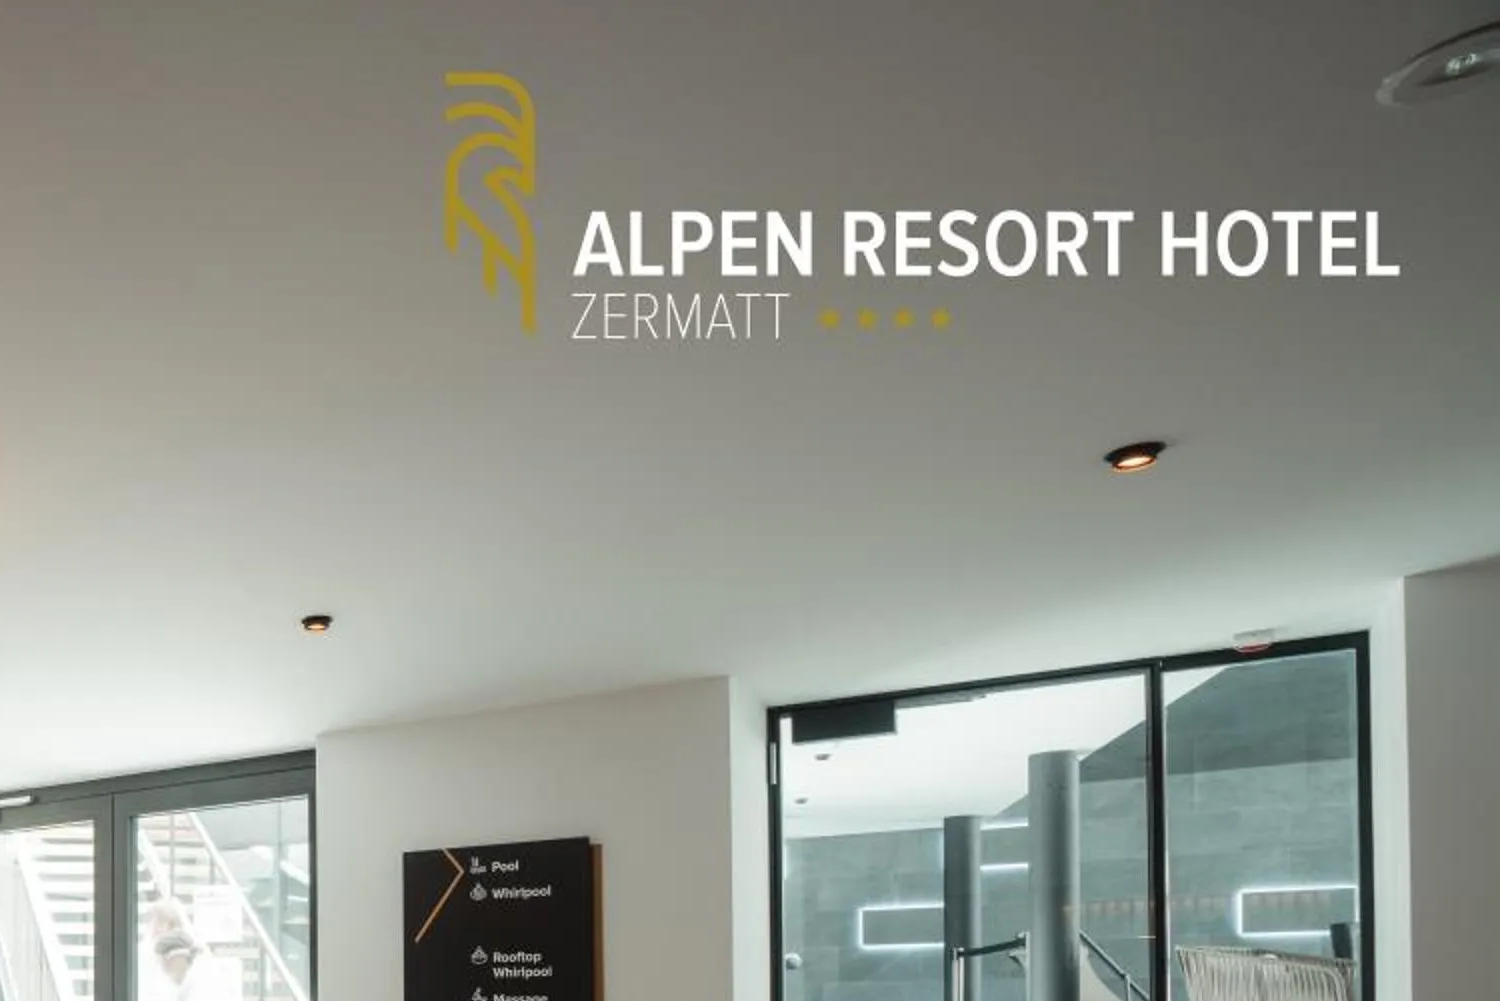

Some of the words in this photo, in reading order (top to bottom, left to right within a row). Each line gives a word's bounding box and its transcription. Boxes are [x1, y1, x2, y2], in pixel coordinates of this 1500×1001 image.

[491, 859, 520, 873] Pool
[491, 884, 552, 901] Whirlpool
[493, 950, 543, 966] Rooftop
[492, 965, 553, 980] Whirlpool
